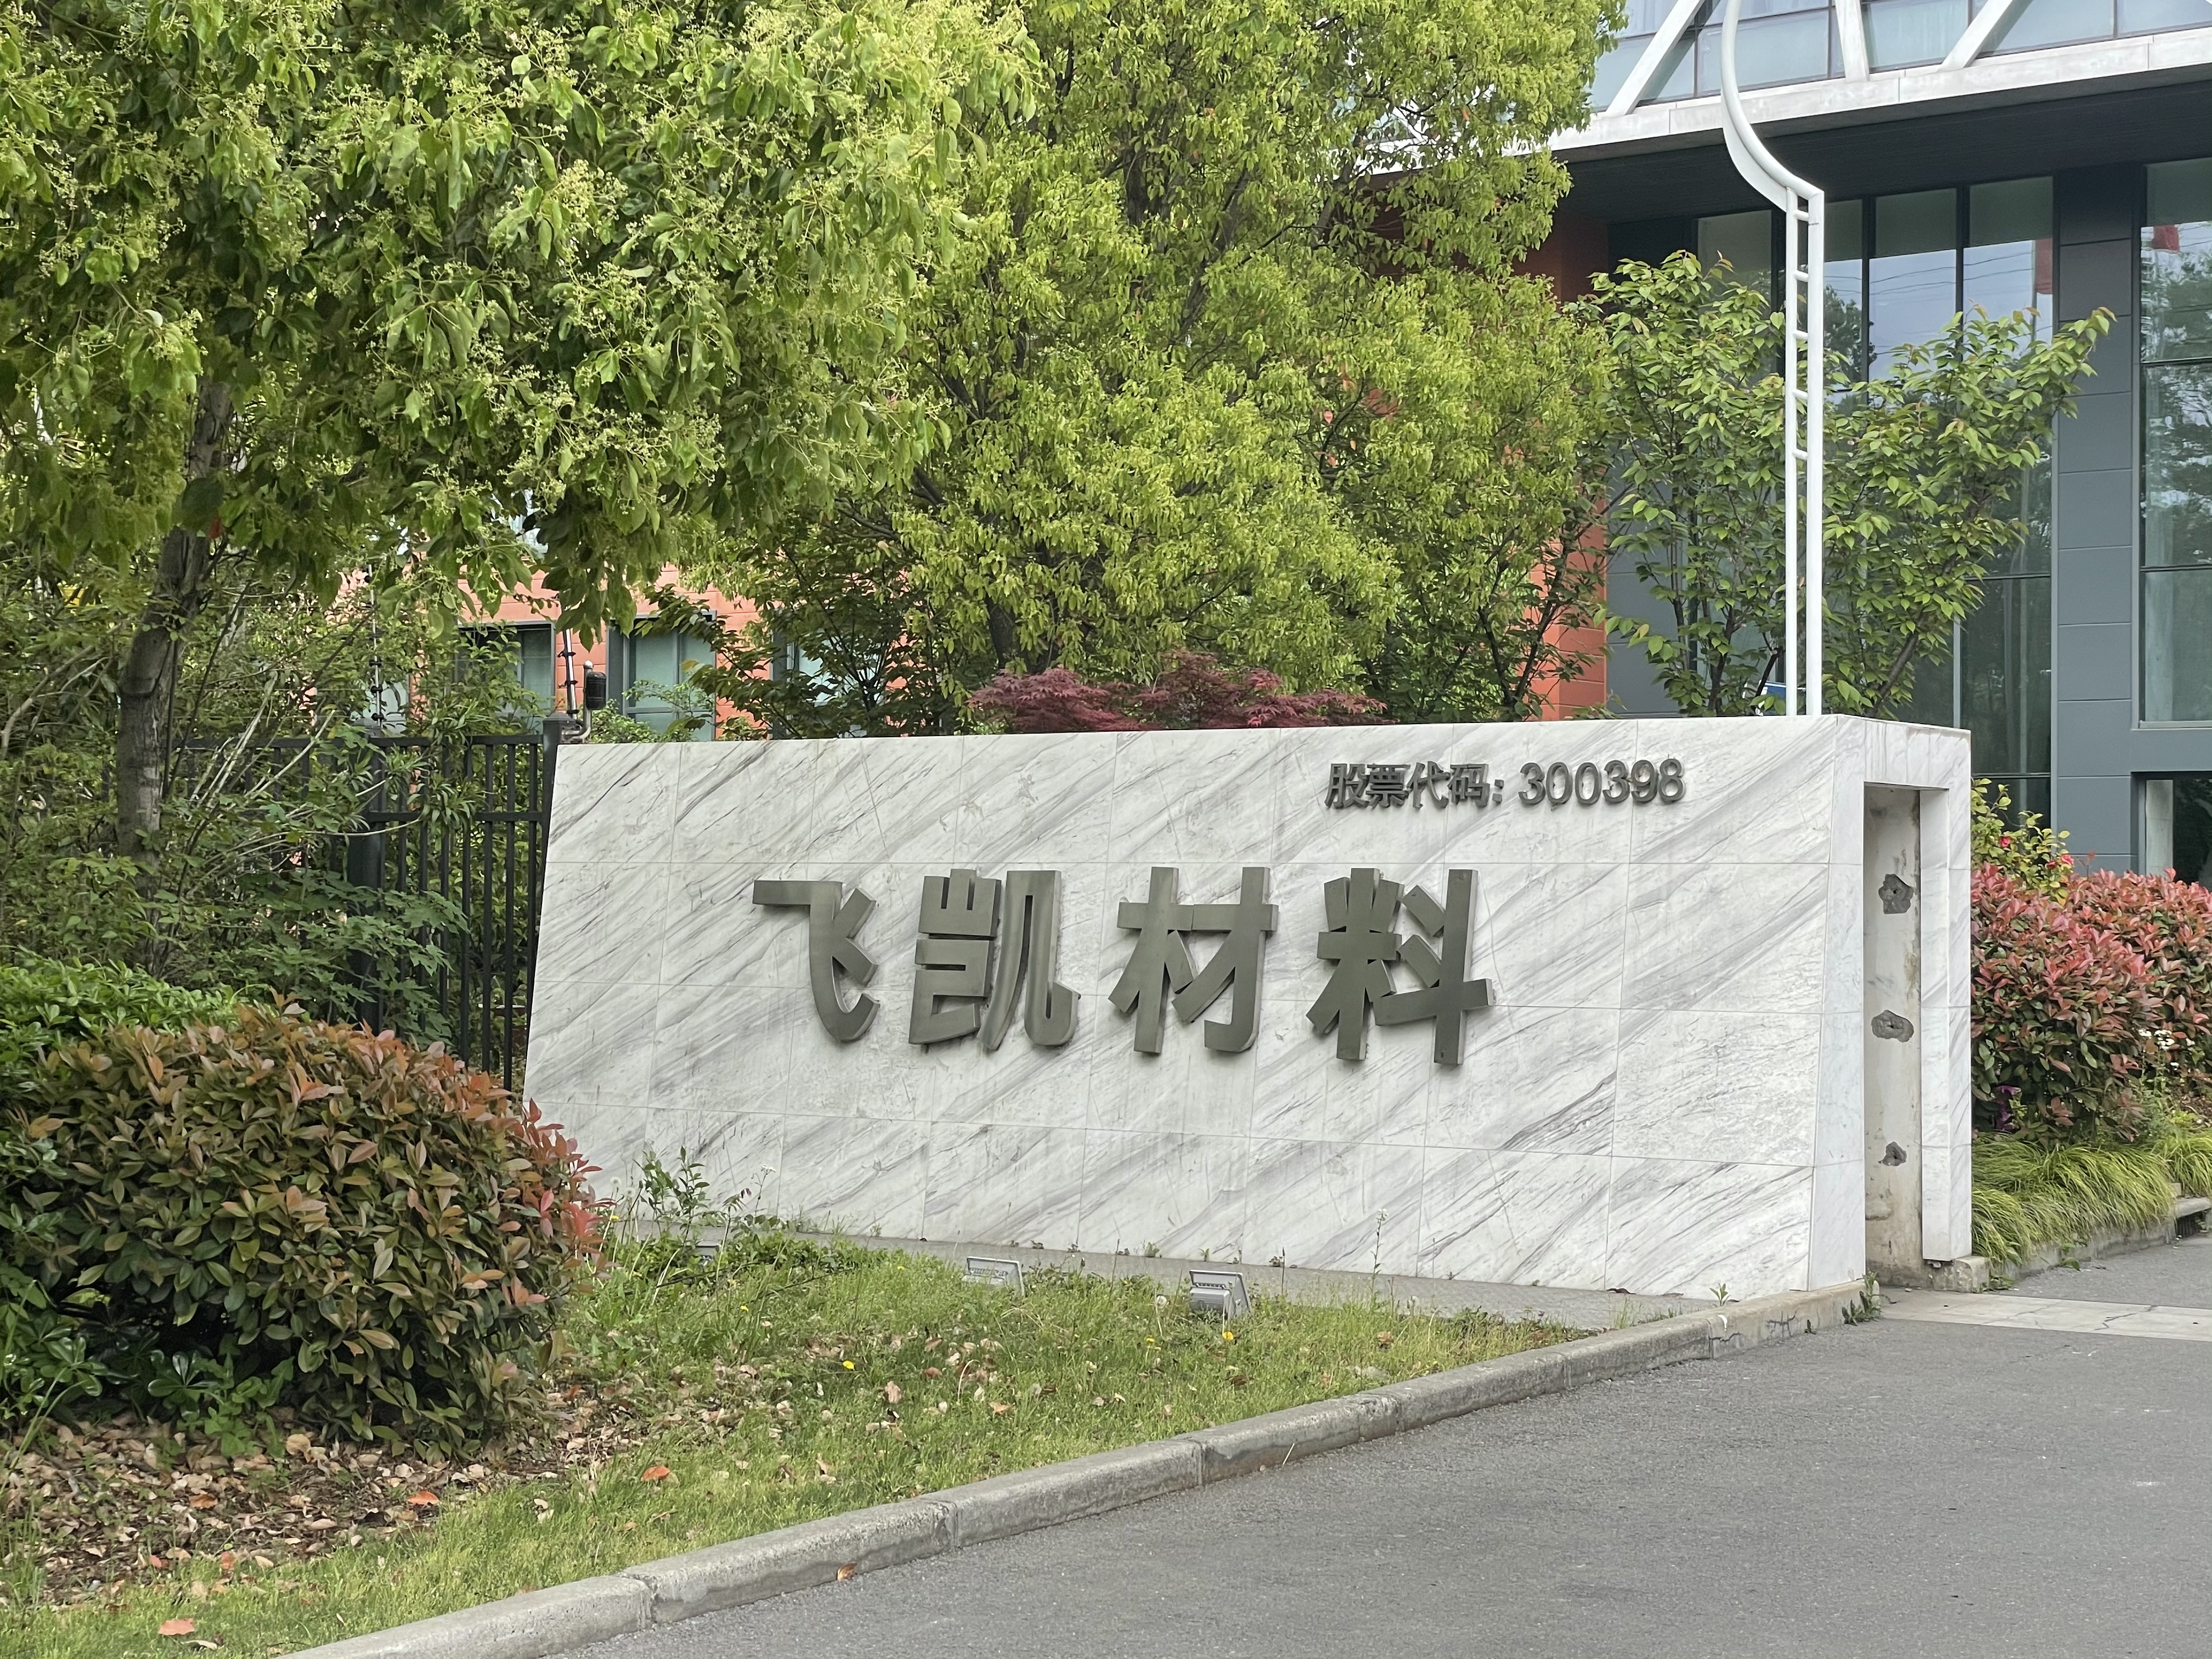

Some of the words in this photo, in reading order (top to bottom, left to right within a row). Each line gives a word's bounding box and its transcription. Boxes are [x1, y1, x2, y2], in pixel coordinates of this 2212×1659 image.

[1518, 758, 1686, 807] 300398
[753, 867, 1493, 1065] 飞凯材料
